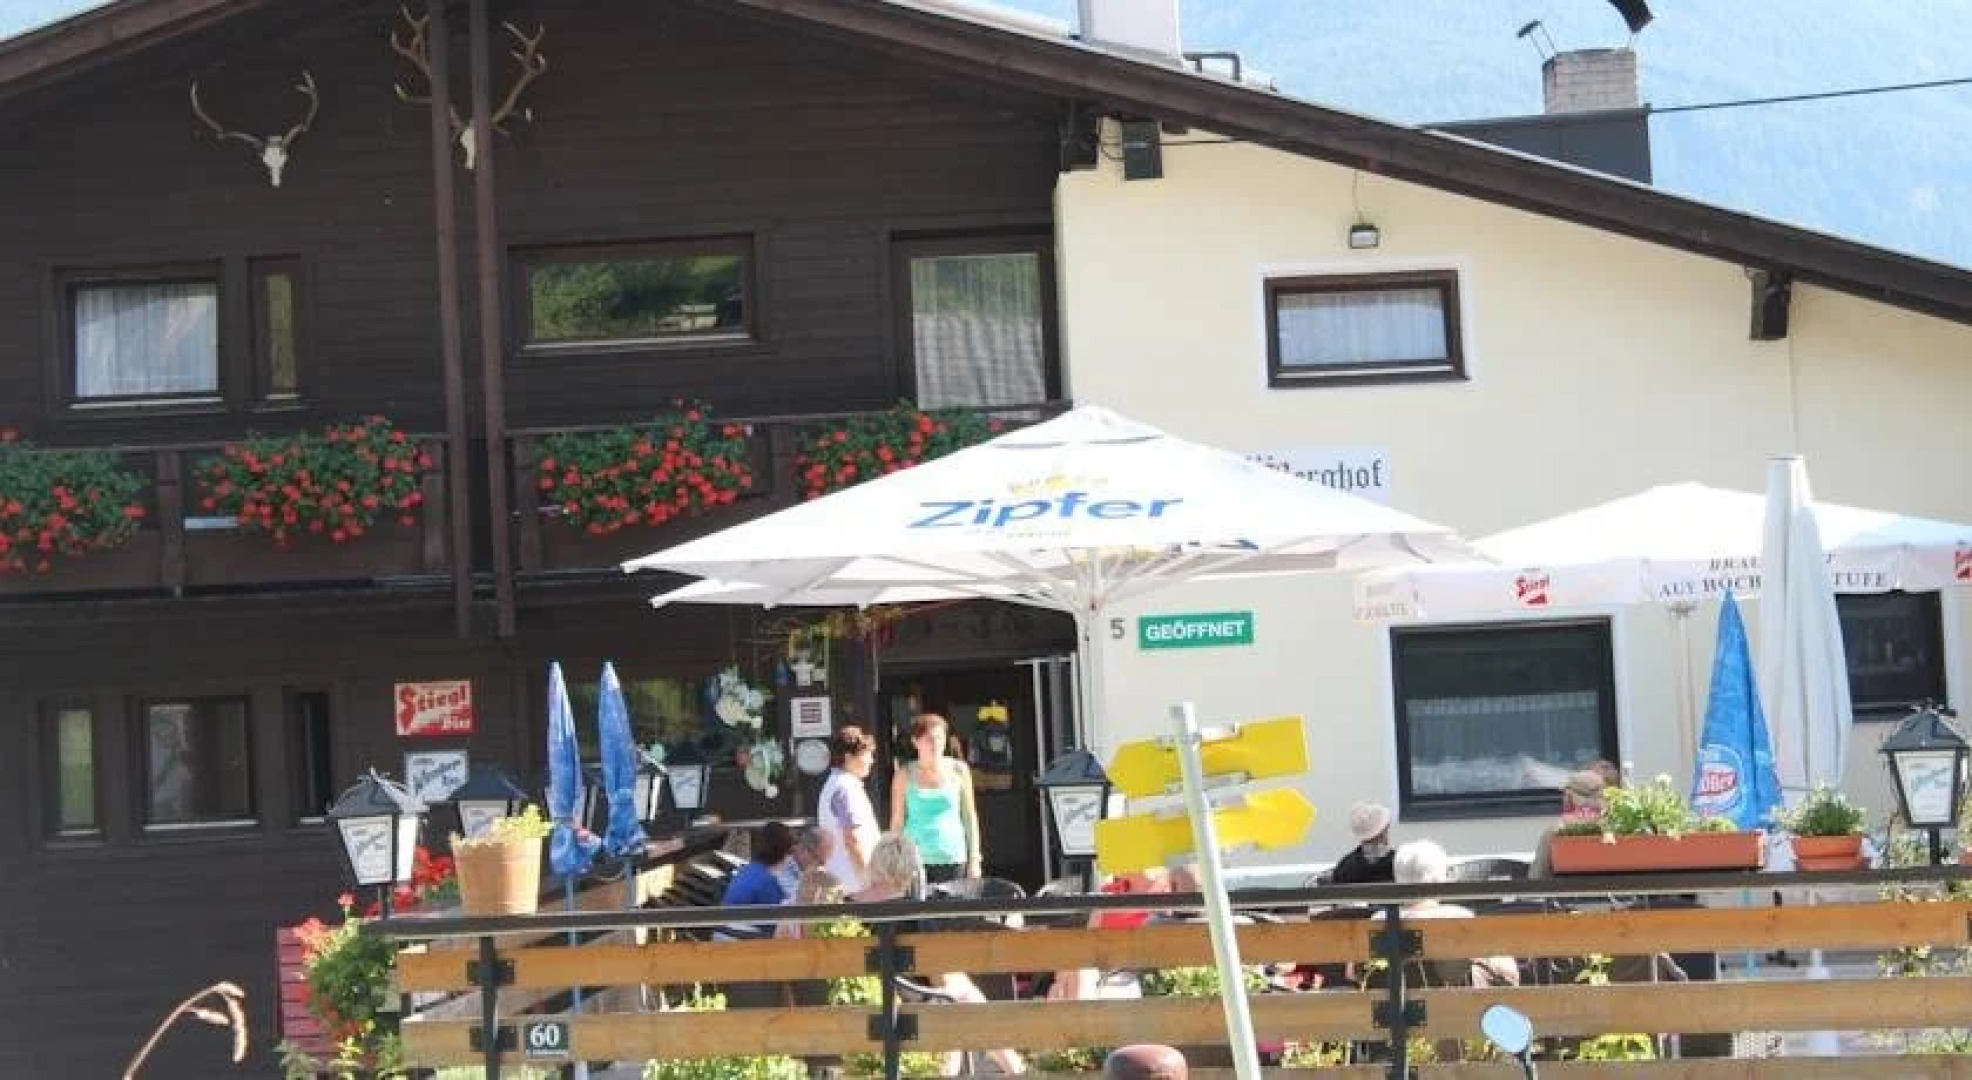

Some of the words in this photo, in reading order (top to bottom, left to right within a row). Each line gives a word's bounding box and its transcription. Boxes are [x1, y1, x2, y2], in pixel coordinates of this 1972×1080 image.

[906, 491, 1184, 528] Zipfer
[1109, 618, 1126, 640] 5
[1145, 618, 1245, 642] GEÖFFNET
[530, 1022, 561, 1048] 60
